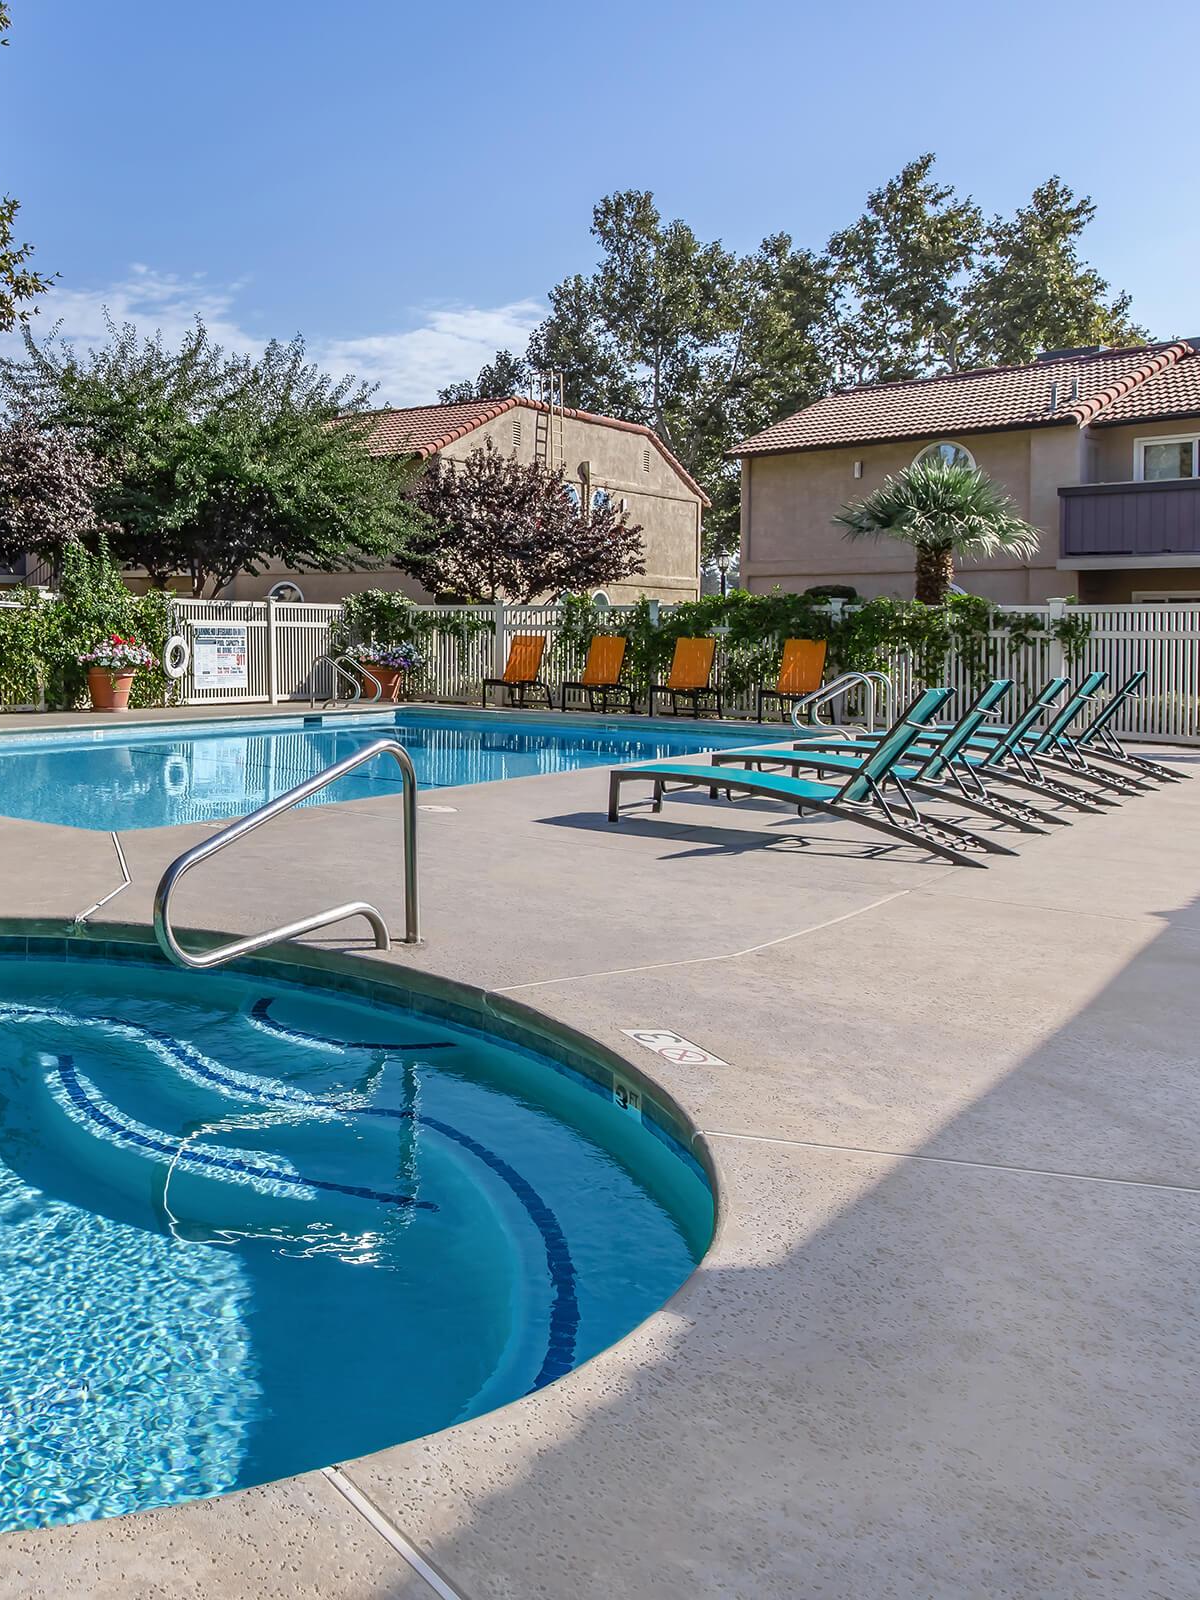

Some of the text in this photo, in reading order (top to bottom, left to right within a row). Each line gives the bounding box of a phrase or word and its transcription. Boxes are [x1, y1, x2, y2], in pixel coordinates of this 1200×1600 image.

[236, 654, 245, 665] 911
[616, 1084, 639, 1110] 3 FT
